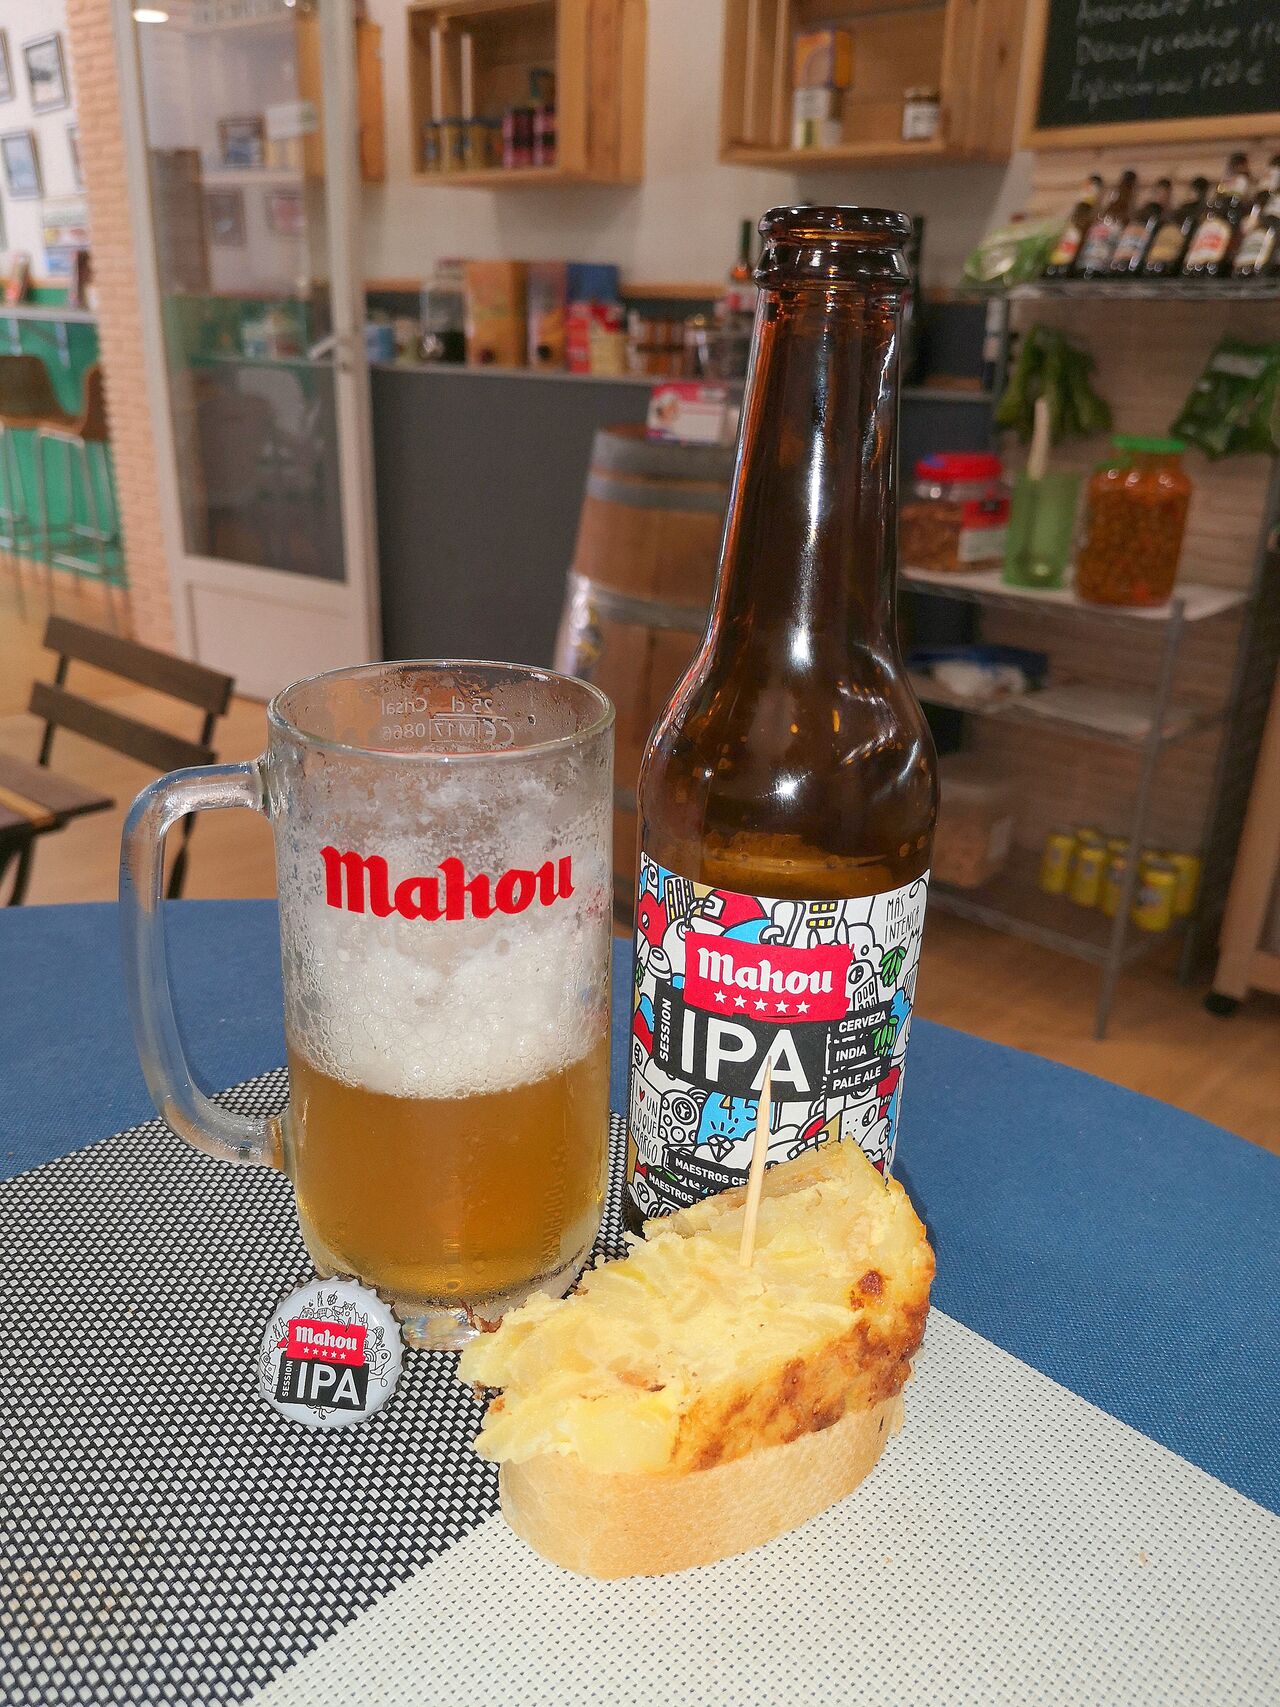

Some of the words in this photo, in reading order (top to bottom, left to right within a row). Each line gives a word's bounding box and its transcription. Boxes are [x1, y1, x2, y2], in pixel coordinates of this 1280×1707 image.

[320, 845, 575, 922] Mahou
[886, 890, 905, 922] MÁS
[697, 947, 833, 994] Mahou
[659, 998, 673, 1062] SESSION
[838, 1010, 886, 1033] CERVEZA
[681, 1008, 810, 1093] IPA
[835, 1044, 867, 1062] INDIA
[832, 1072, 861, 1091] PALE
[862, 1065, 882, 1085] ALE
[634, 1100, 658, 1140] TOQUE
[646, 1096, 659, 1118] UN
[675, 1157, 729, 1184] MAESTROS
[648, 1172, 694, 1204] MAESTROS
[295, 1326, 358, 1351] Mahou
[282, 1360, 294, 1397] SESSION
[297, 1361, 360, 1406] IPA
